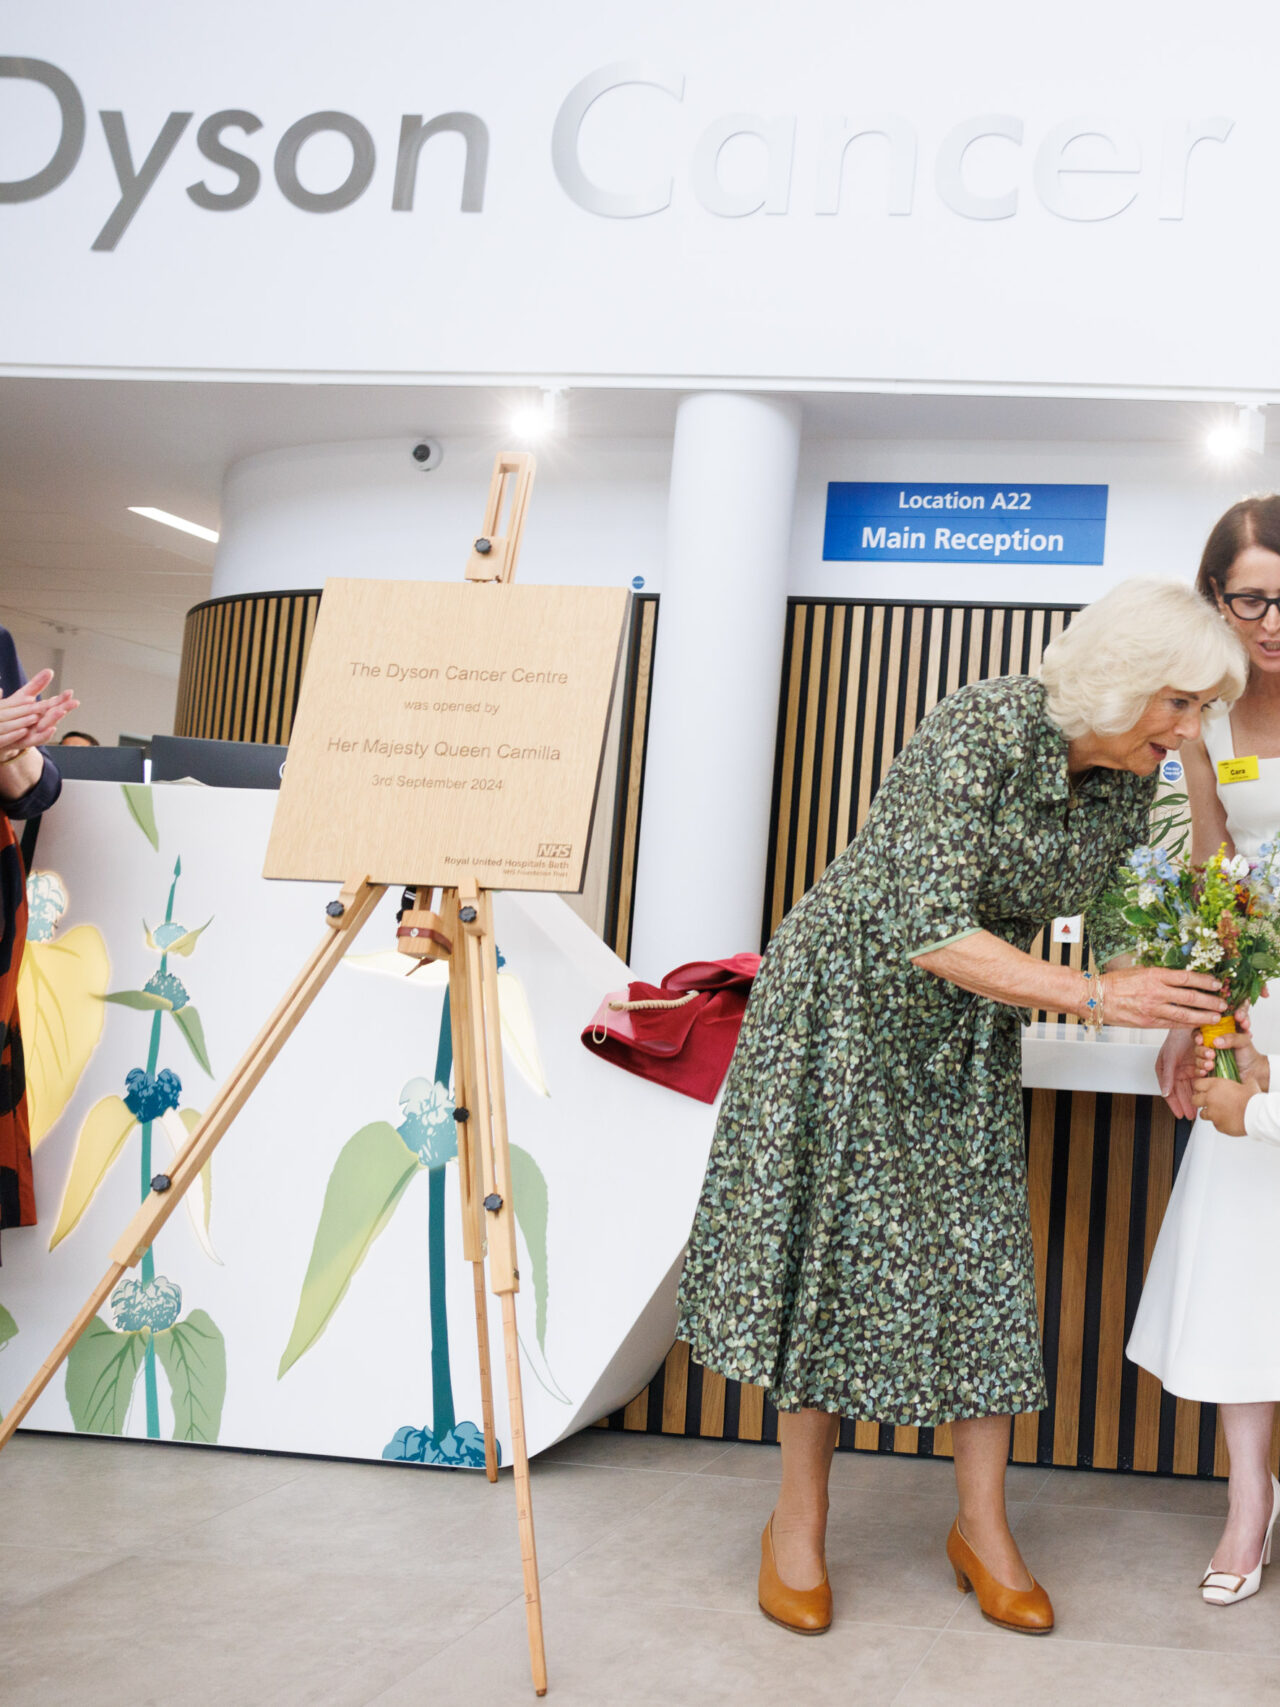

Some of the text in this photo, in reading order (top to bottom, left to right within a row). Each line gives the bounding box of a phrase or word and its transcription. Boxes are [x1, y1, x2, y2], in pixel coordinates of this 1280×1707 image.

[0, 55, 490, 253] Dyson
[550, 58, 1236, 223] Cancer
[899, 491, 1032, 510] Location A22
[862, 526, 1064, 556] Main Reception
[349, 662, 568, 684] The Dyson Cancer Centre
[404, 700, 500, 716] was opened by
[327, 737, 561, 761] Her Majesty Queen Camilla
[371, 774, 504, 792] 3rd September 2024
[537, 844, 571, 857] NHS
[444, 856, 569, 869] Royal United Hospitals Bath
